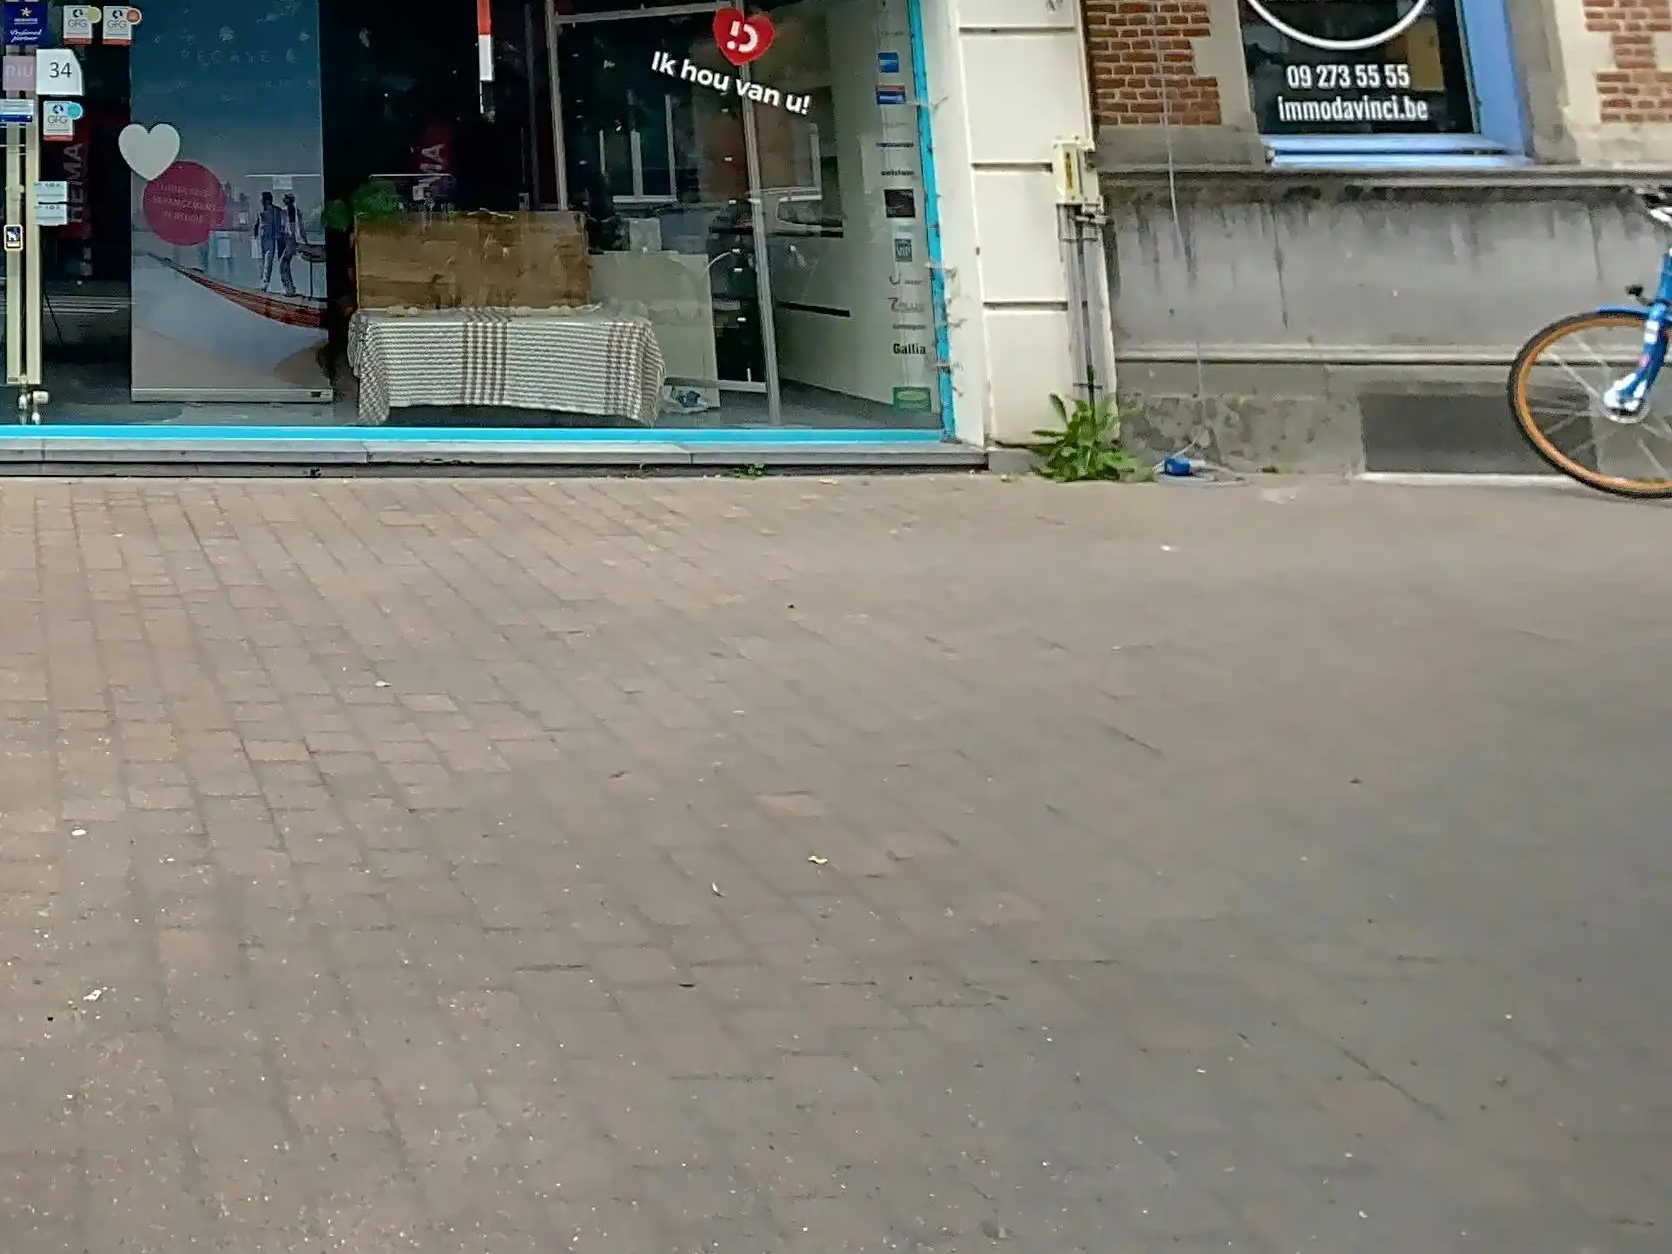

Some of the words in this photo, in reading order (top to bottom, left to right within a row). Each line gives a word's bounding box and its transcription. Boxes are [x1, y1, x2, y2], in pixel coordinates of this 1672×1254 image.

[5, 64, 33, 77] RIU
[49, 62, 73, 79] 34
[1286, 65, 1312, 89] 09
[1316, 65, 1351, 89] 273
[1355, 64, 1380, 88] 55
[1383, 64, 1411, 88] 55
[651, 51, 676, 77] Ik
[680, 58, 730, 91] hou
[736, 79, 781, 107] van
[785, 94, 811, 115] u!
[1278, 96, 1429, 121] immodavinci.be
[893, 342, 926, 355] Gallia
